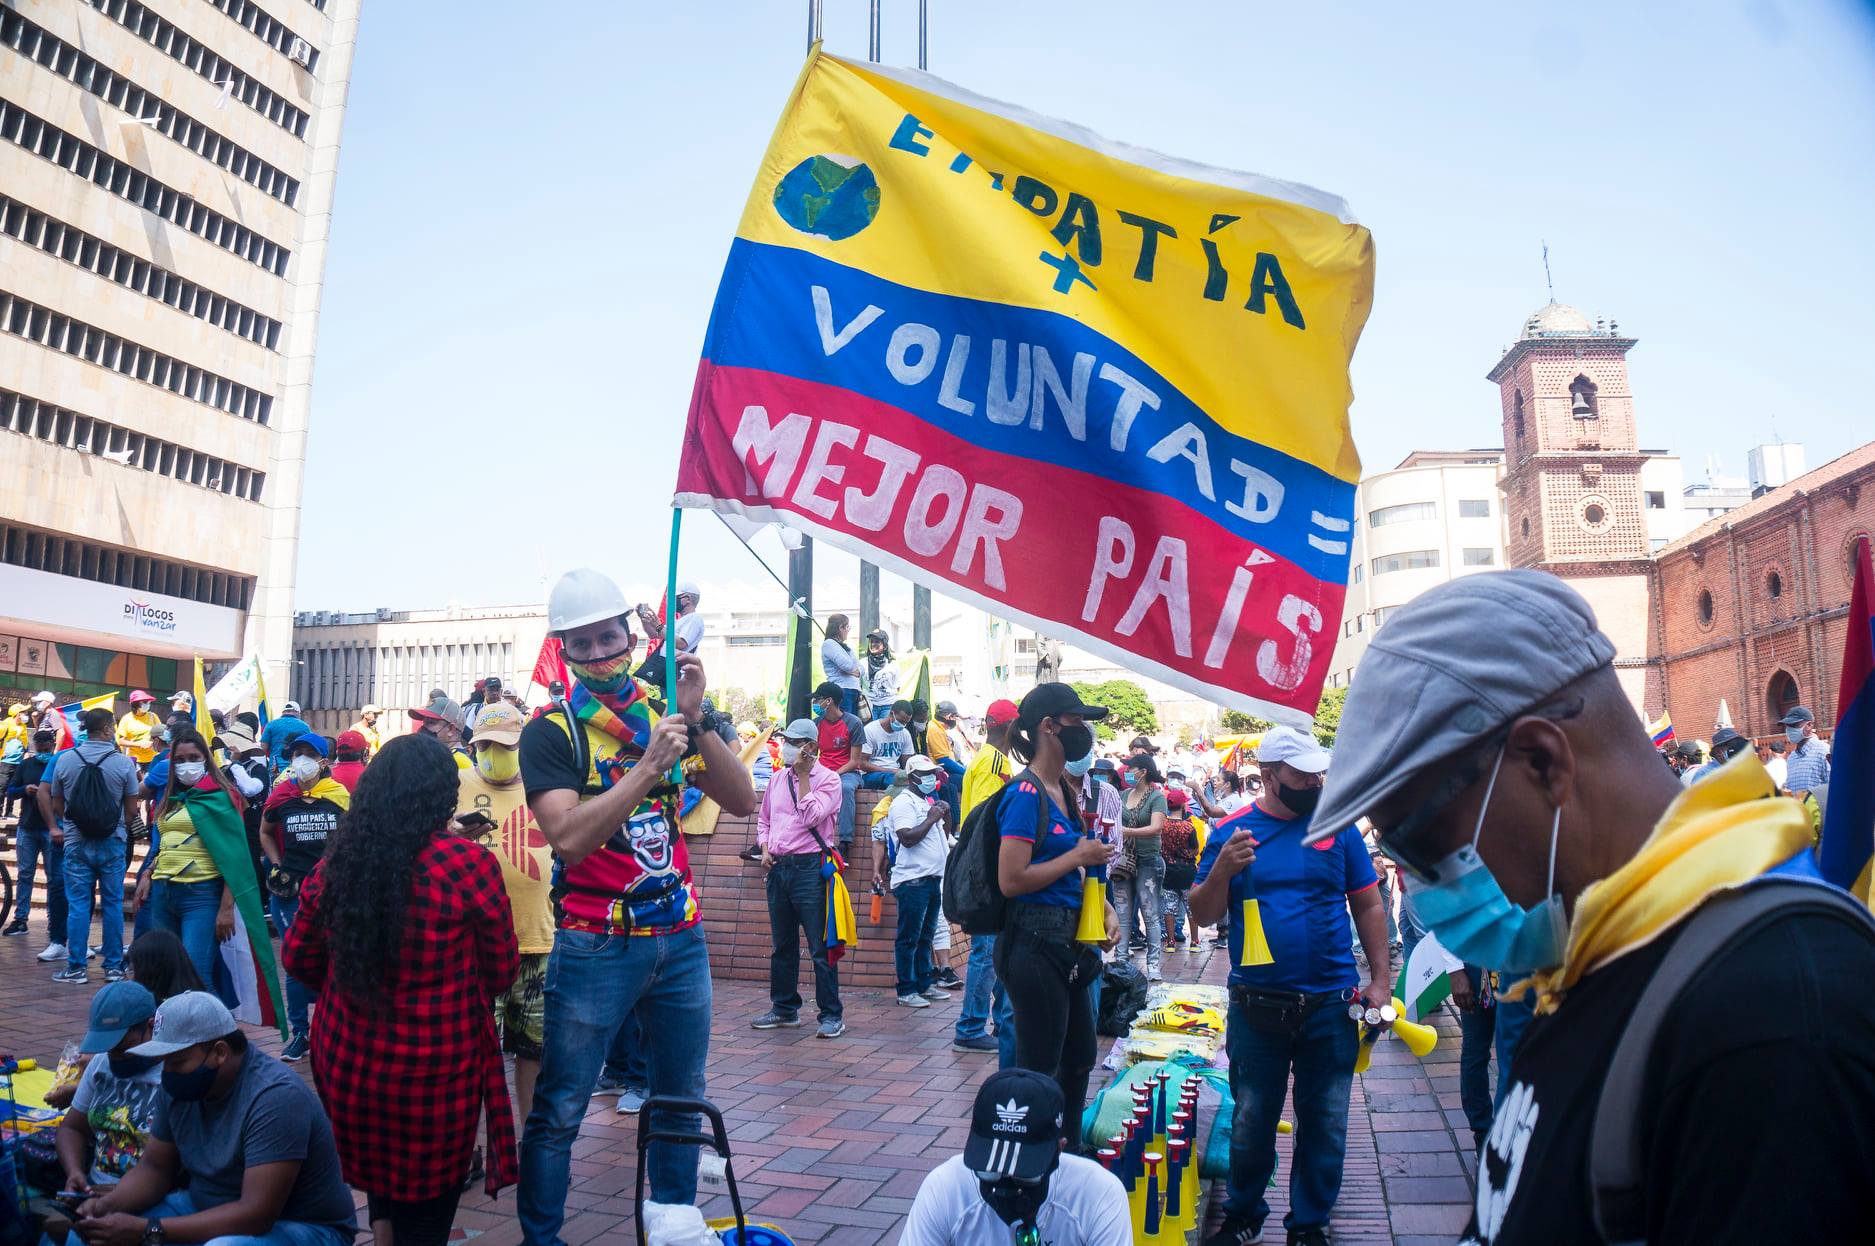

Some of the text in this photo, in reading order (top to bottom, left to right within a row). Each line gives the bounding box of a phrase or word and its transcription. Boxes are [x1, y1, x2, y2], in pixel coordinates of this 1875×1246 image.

[889, 113, 1306, 330] EPATÍA
[811, 285, 1350, 555] VOLUNTAD =
[732, 405, 1323, 691] MEJOR PAÍS
[287, 815, 300, 823] AMO
[300, 814, 309, 823] MI
[295, 832, 327, 841] GOBIERNO
[992, 1122, 1028, 1134] adidas
